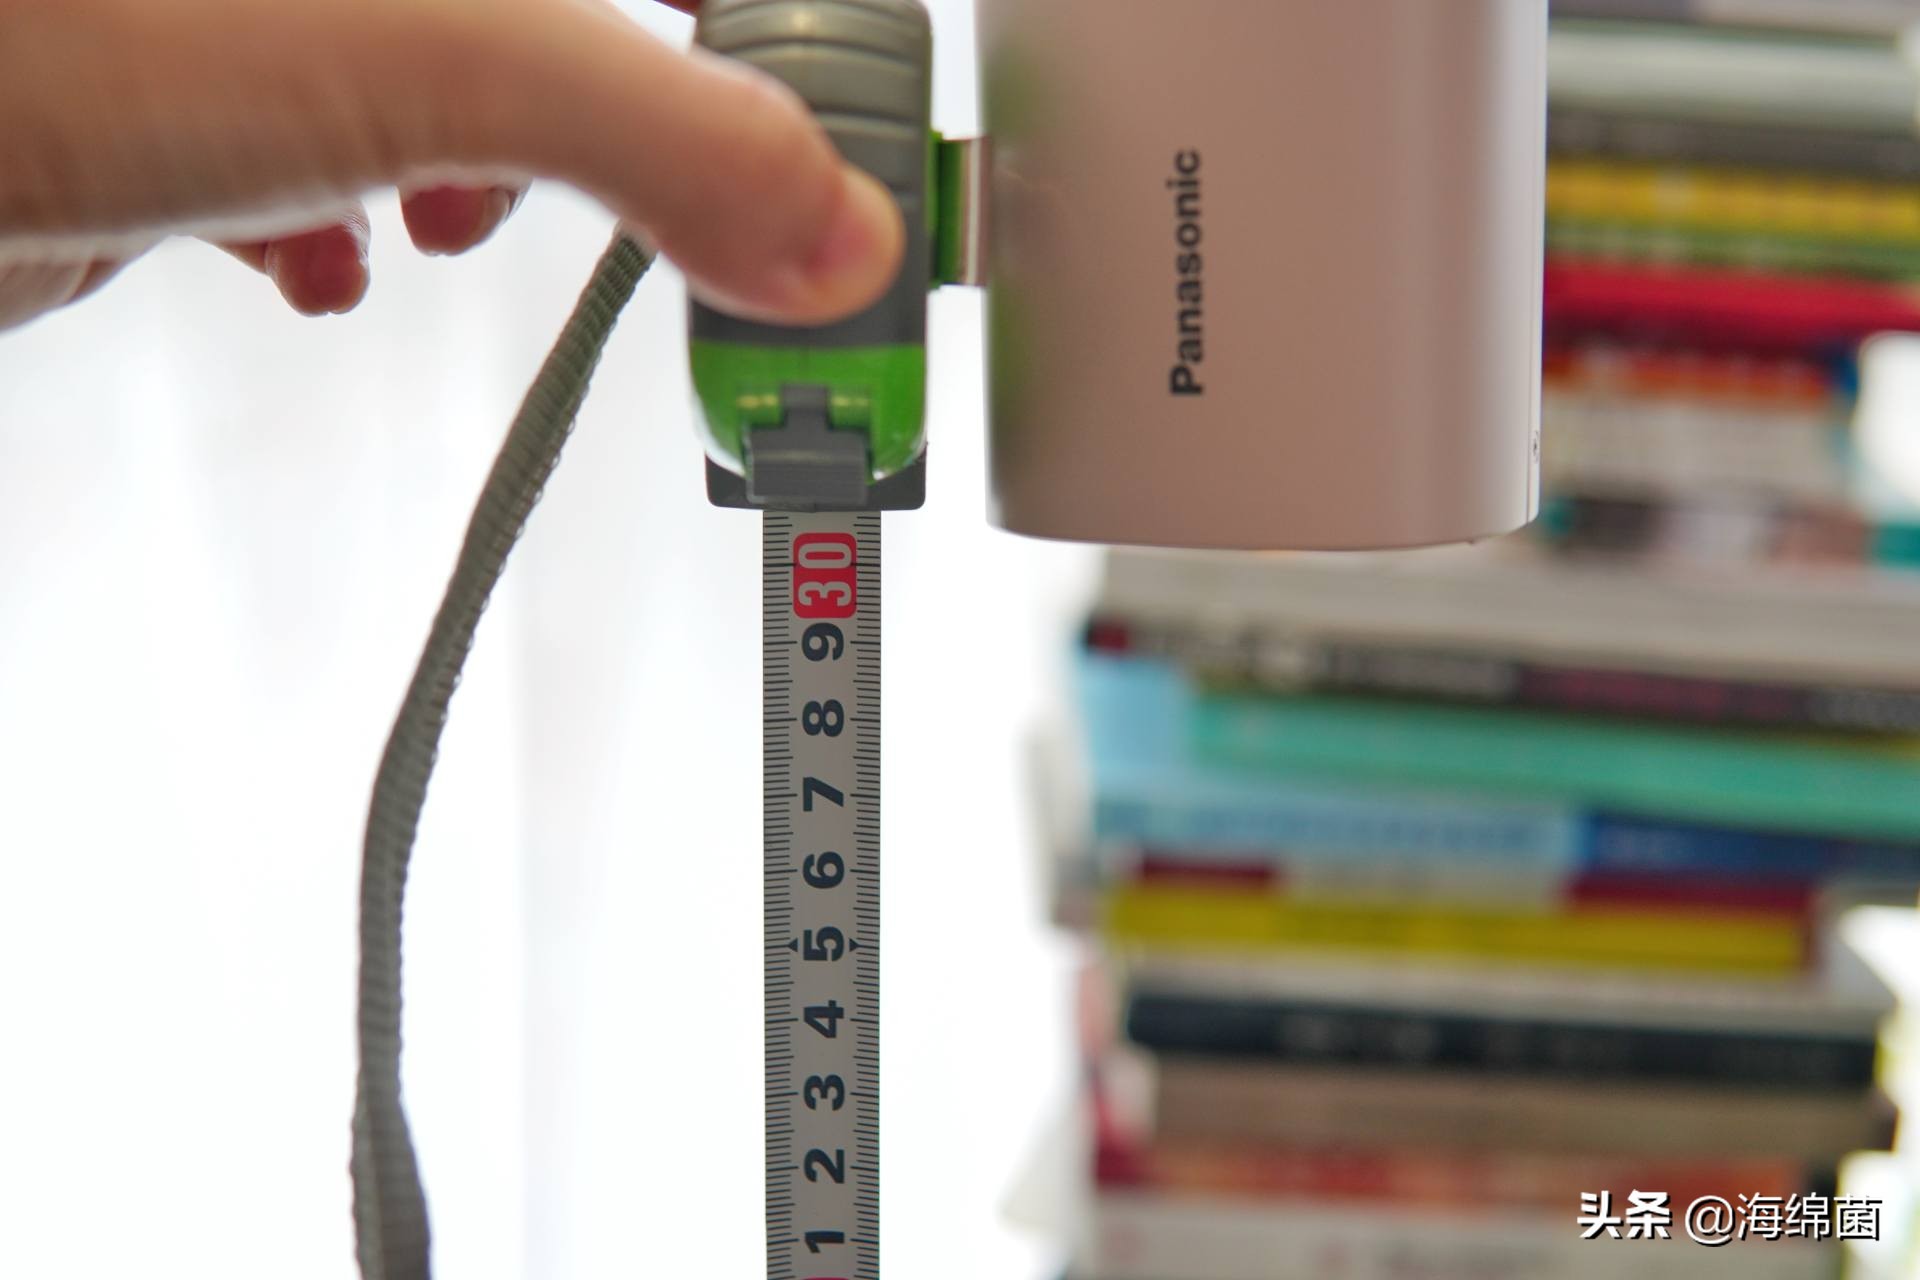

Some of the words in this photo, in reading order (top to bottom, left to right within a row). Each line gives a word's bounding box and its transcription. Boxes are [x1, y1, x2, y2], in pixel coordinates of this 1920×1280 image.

[1166, 149, 1204, 396] Panasonic
[798, 541, 852, 607] 30
[801, 622, 844, 662] 9
[802, 699, 844, 737] 8
[803, 777, 844, 812] 7
[802, 851, 845, 889] 6
[803, 926, 844, 961] 5
[803, 1000, 844, 1039] 4
[803, 1073, 845, 1111] 3
[804, 1148, 845, 1184] 2
[804, 1231, 845, 1254] 1
